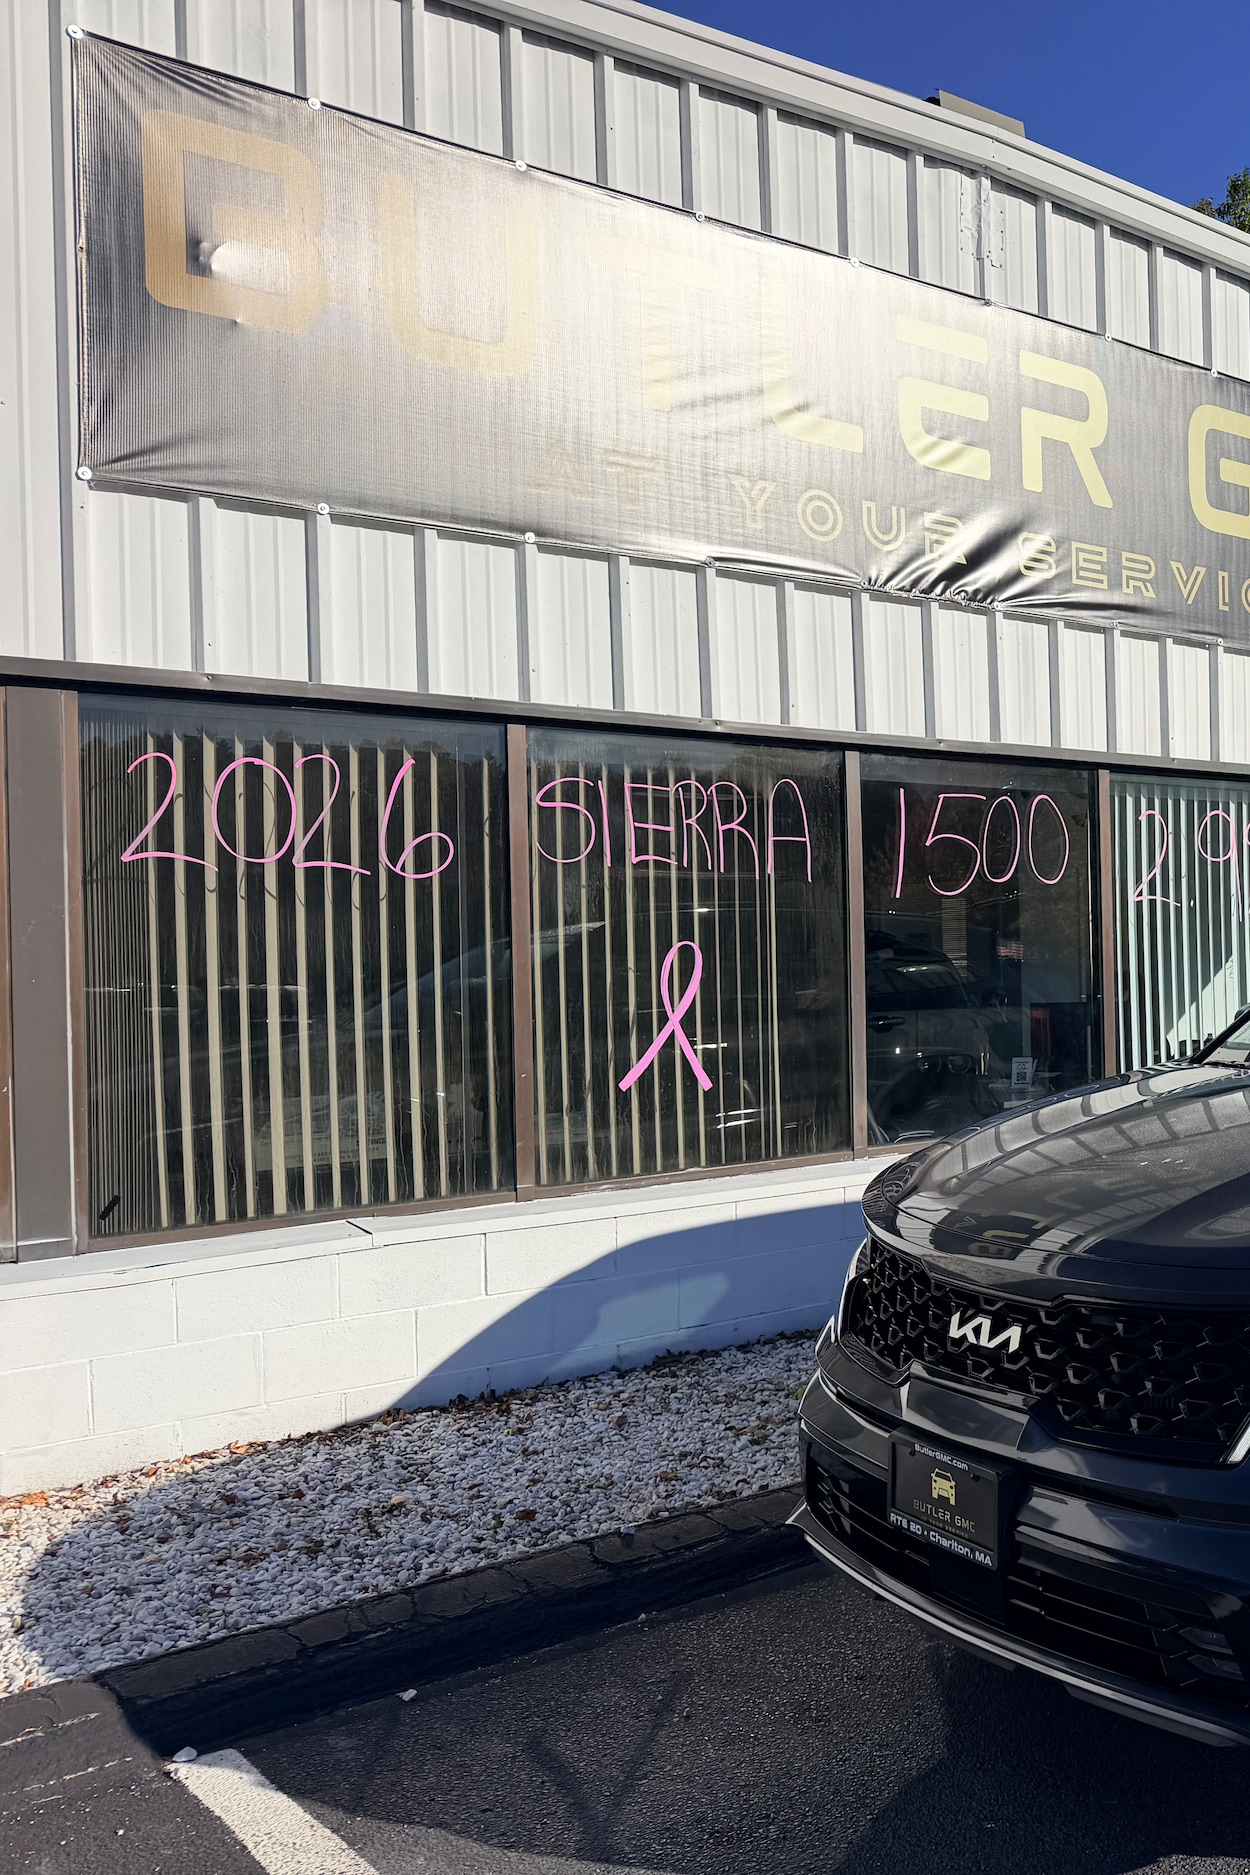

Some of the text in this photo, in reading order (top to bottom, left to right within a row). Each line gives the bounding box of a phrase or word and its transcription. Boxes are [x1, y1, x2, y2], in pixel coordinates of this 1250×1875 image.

[731, 476, 969, 566] YOUR
[120, 752, 455, 879] 2026
[534, 776, 812, 883] SIERRA
[894, 788, 1070, 898] 1500
[914, 1443, 969, 1471] ButlerGMC.com
[890, 1512, 908, 1529] RTE
[929, 1530, 974, 1559] Charlton,
[975, 1550, 993, 1567] MA
[913, 1499, 976, 1533] BUTLER GMC
